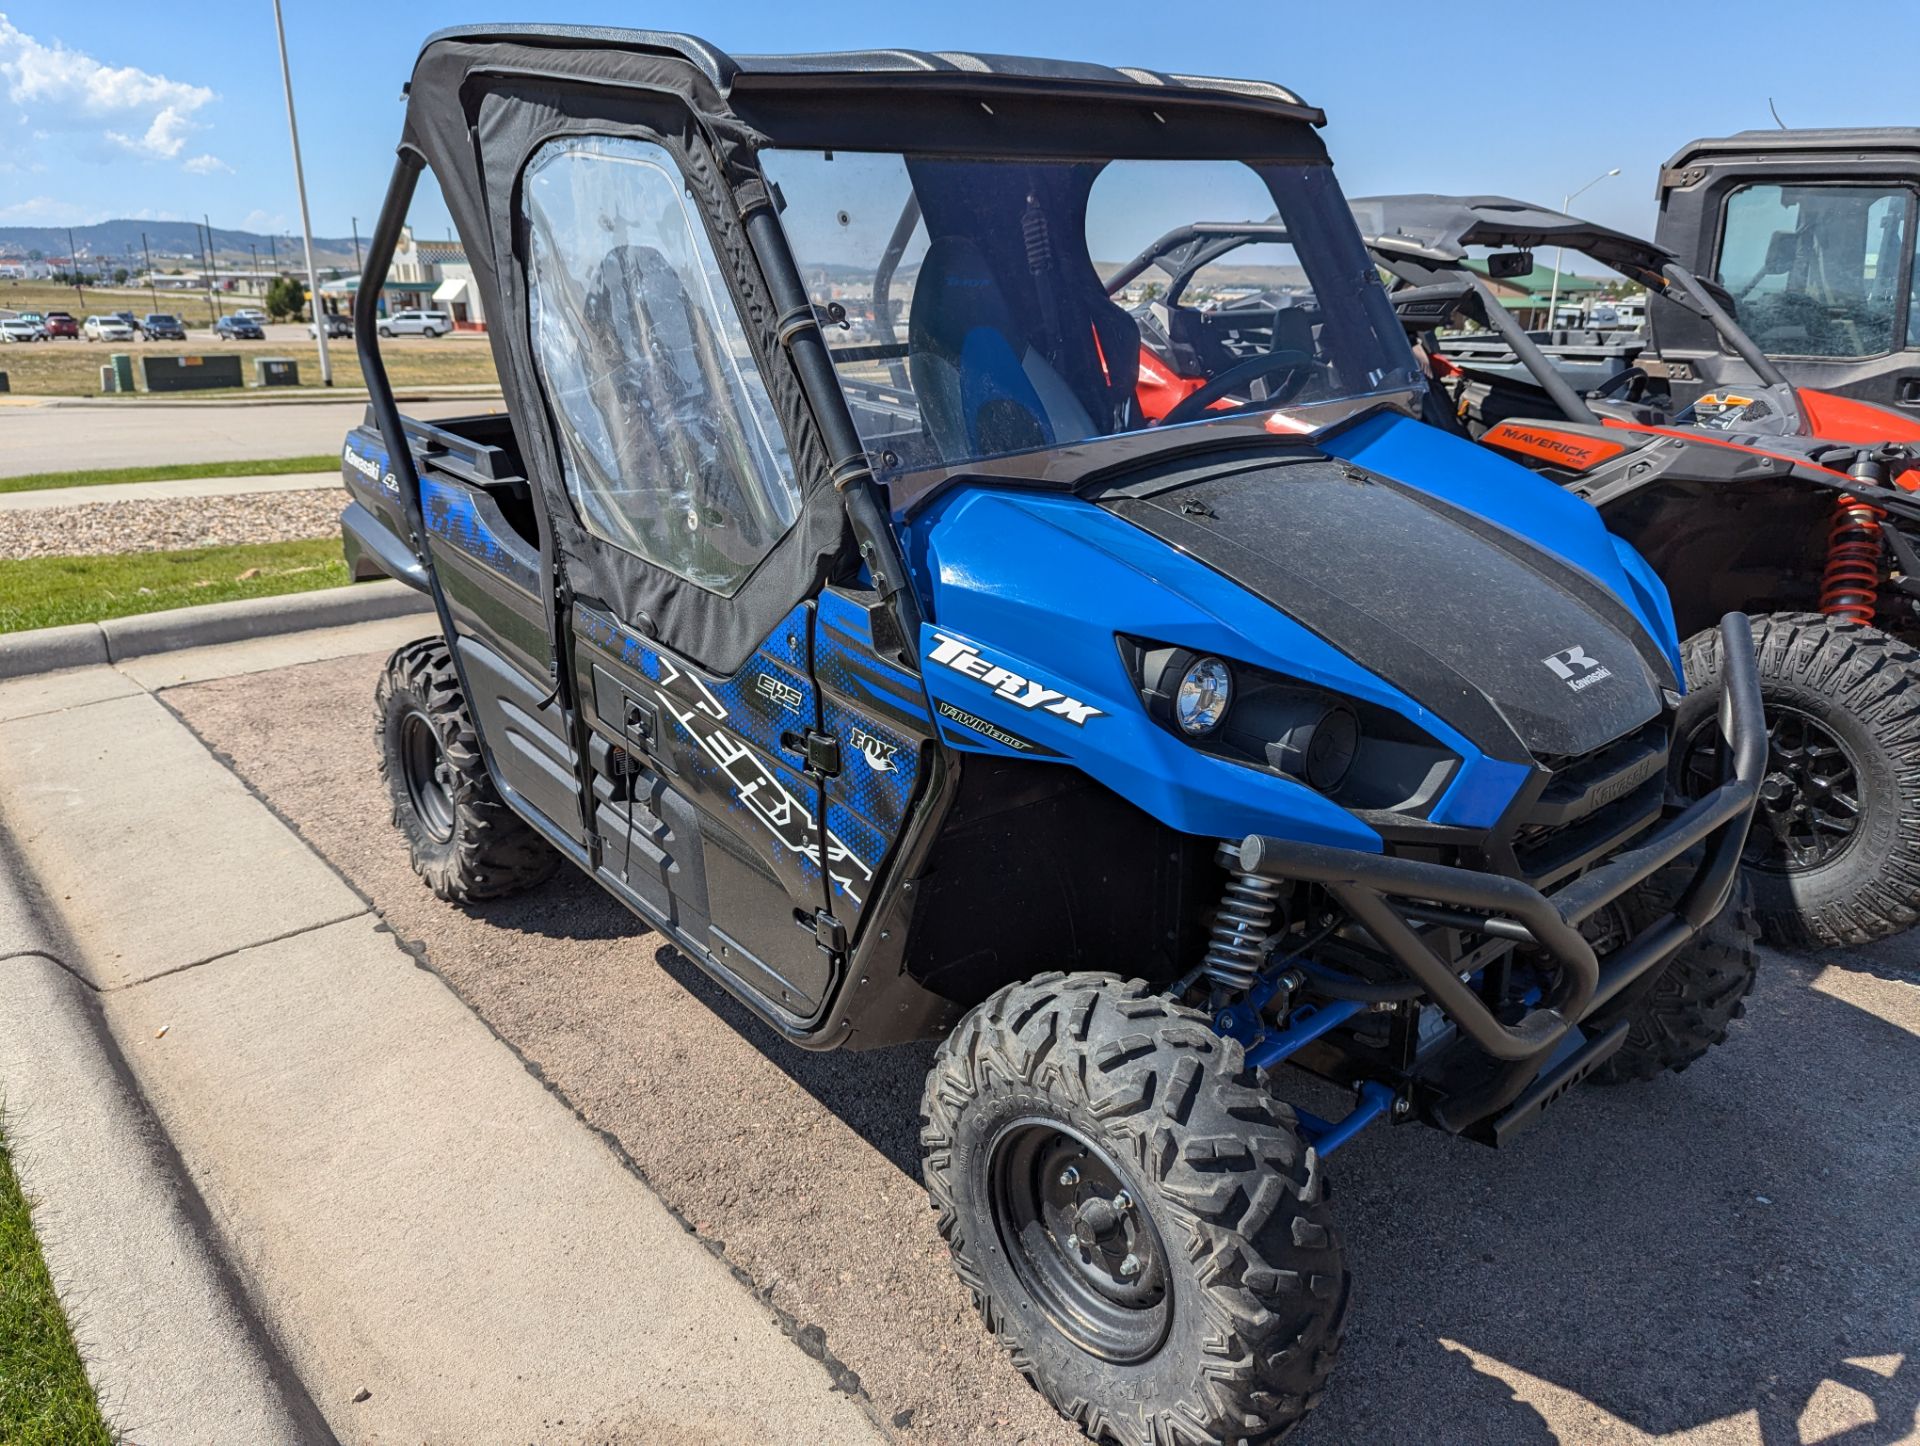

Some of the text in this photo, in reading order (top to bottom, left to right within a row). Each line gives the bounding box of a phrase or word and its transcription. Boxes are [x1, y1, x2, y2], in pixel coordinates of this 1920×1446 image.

[1502, 428, 1592, 459] MAVERICK
[344, 444, 380, 481] Kawasaki
[757, 673, 802, 706] EPS
[926, 632, 1106, 726] TERYX
[1566, 665, 1612, 692] Kawasaki
[850, 727, 898, 762] FOX
